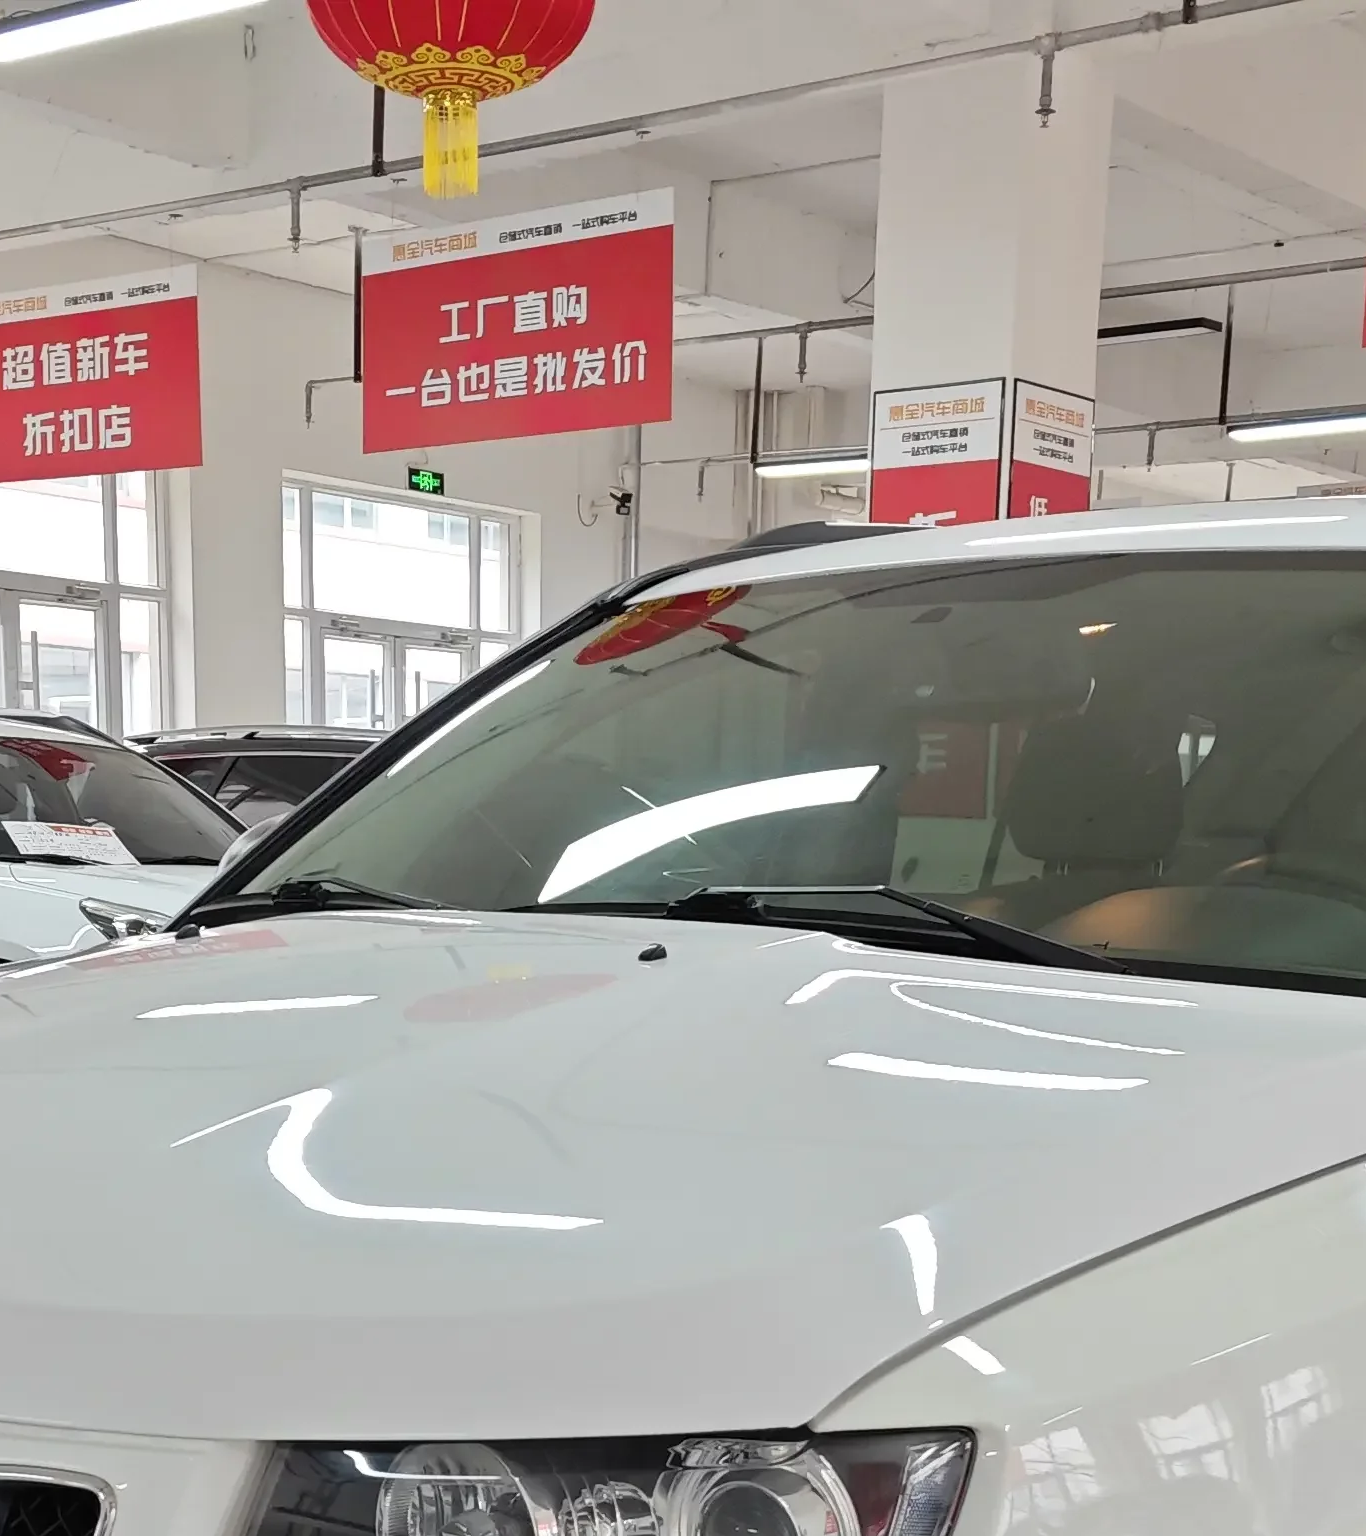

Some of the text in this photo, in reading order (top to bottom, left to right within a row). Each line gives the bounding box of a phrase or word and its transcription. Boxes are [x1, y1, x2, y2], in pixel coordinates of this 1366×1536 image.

[439, 284, 588, 344] 工厂直购
[2, 332, 149, 390] 超值新车
[385, 340, 648, 408] 一台也是批发价
[22, 404, 133, 457] 折扣店
